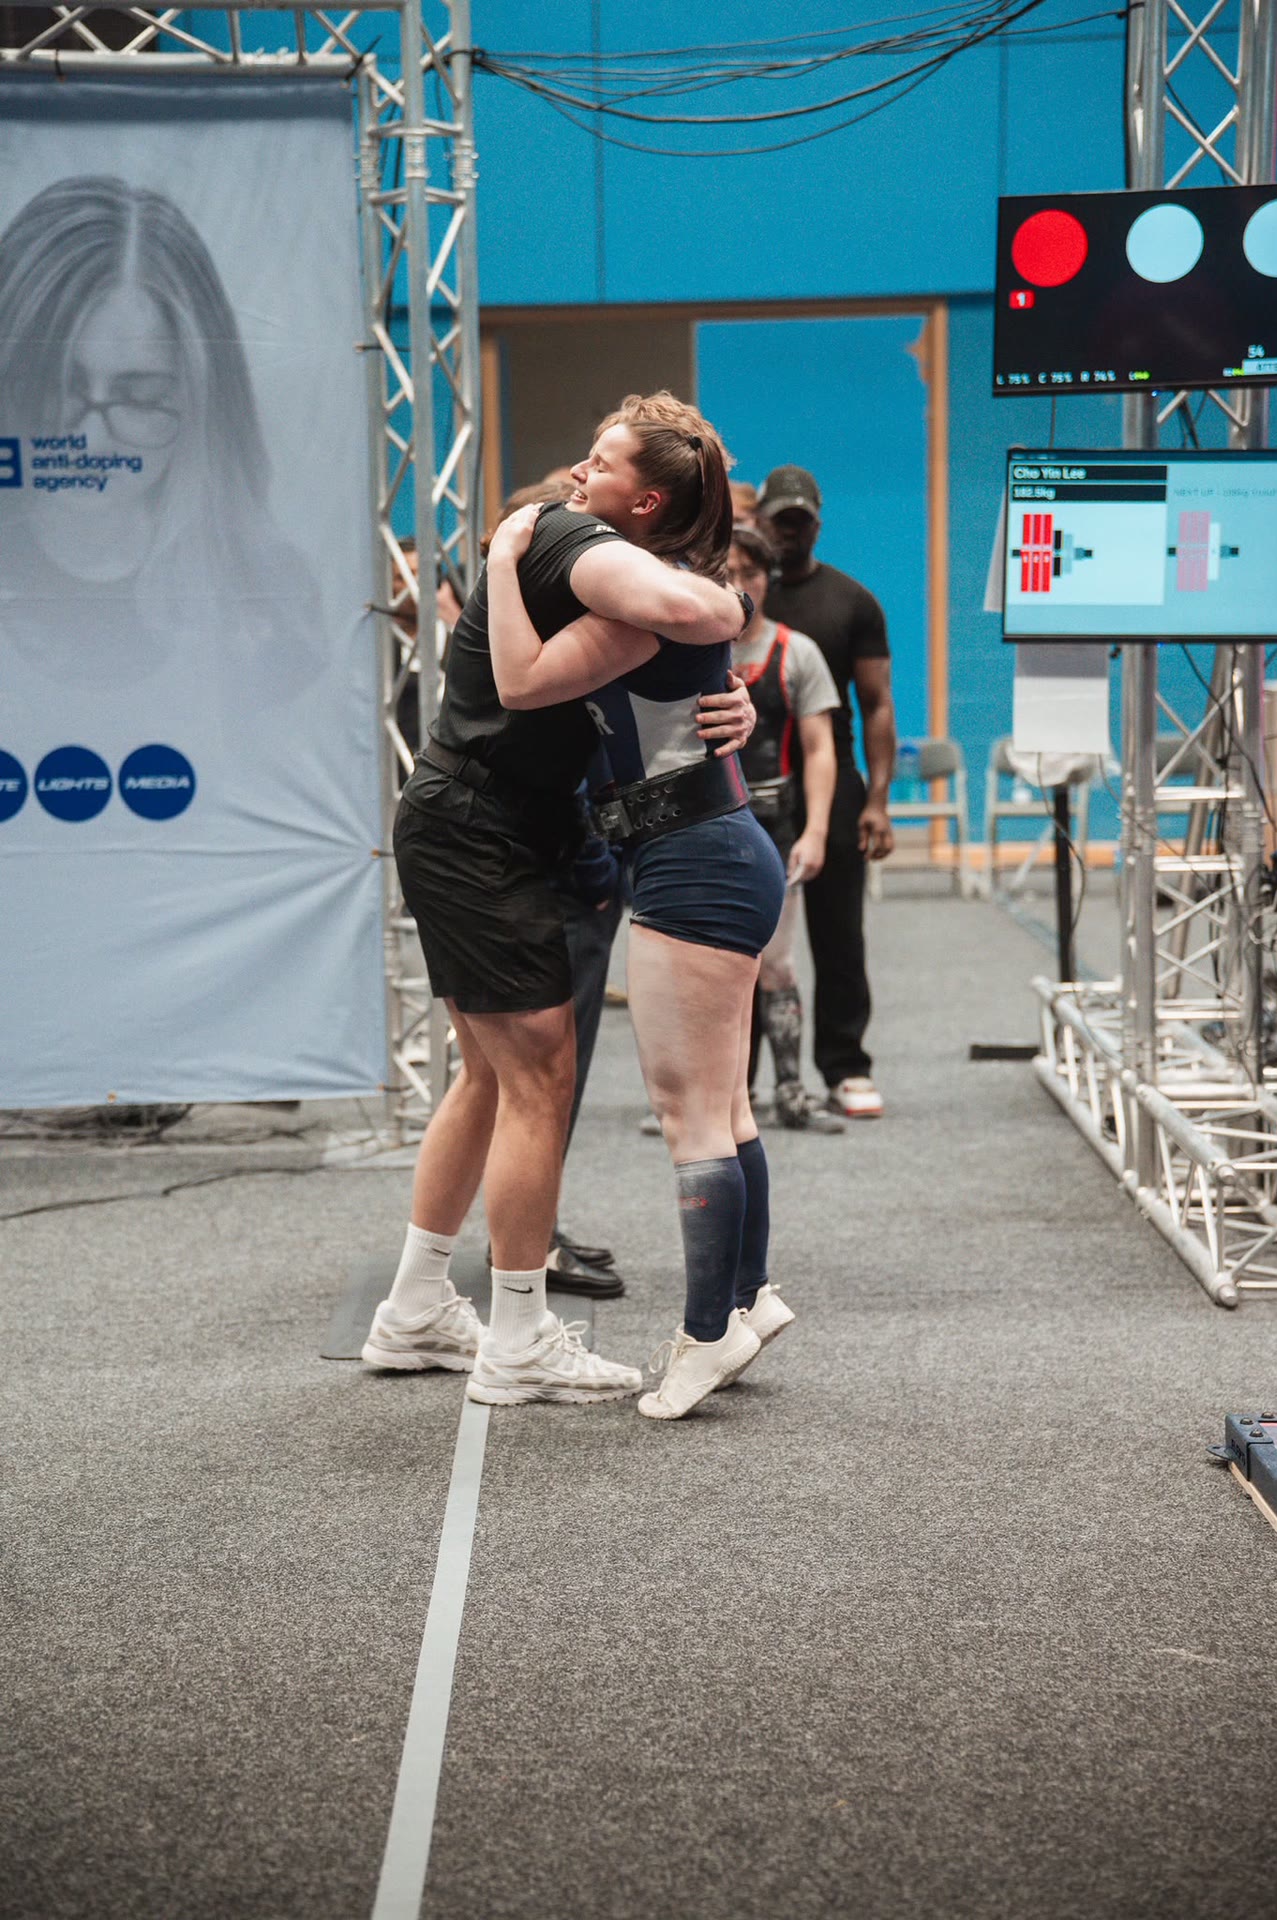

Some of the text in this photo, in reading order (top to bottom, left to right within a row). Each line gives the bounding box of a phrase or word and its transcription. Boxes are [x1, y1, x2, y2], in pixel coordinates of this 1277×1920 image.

[1017, 292, 1026, 307] 1
[31, 434, 87, 450] world
[32, 454, 143, 473] anti-doping
[1062, 466, 1087, 479] Lee
[33, 475, 108, 492] agency
[38, 777, 109, 791] LIGHTS
[125, 776, 190, 790] MEDIA
